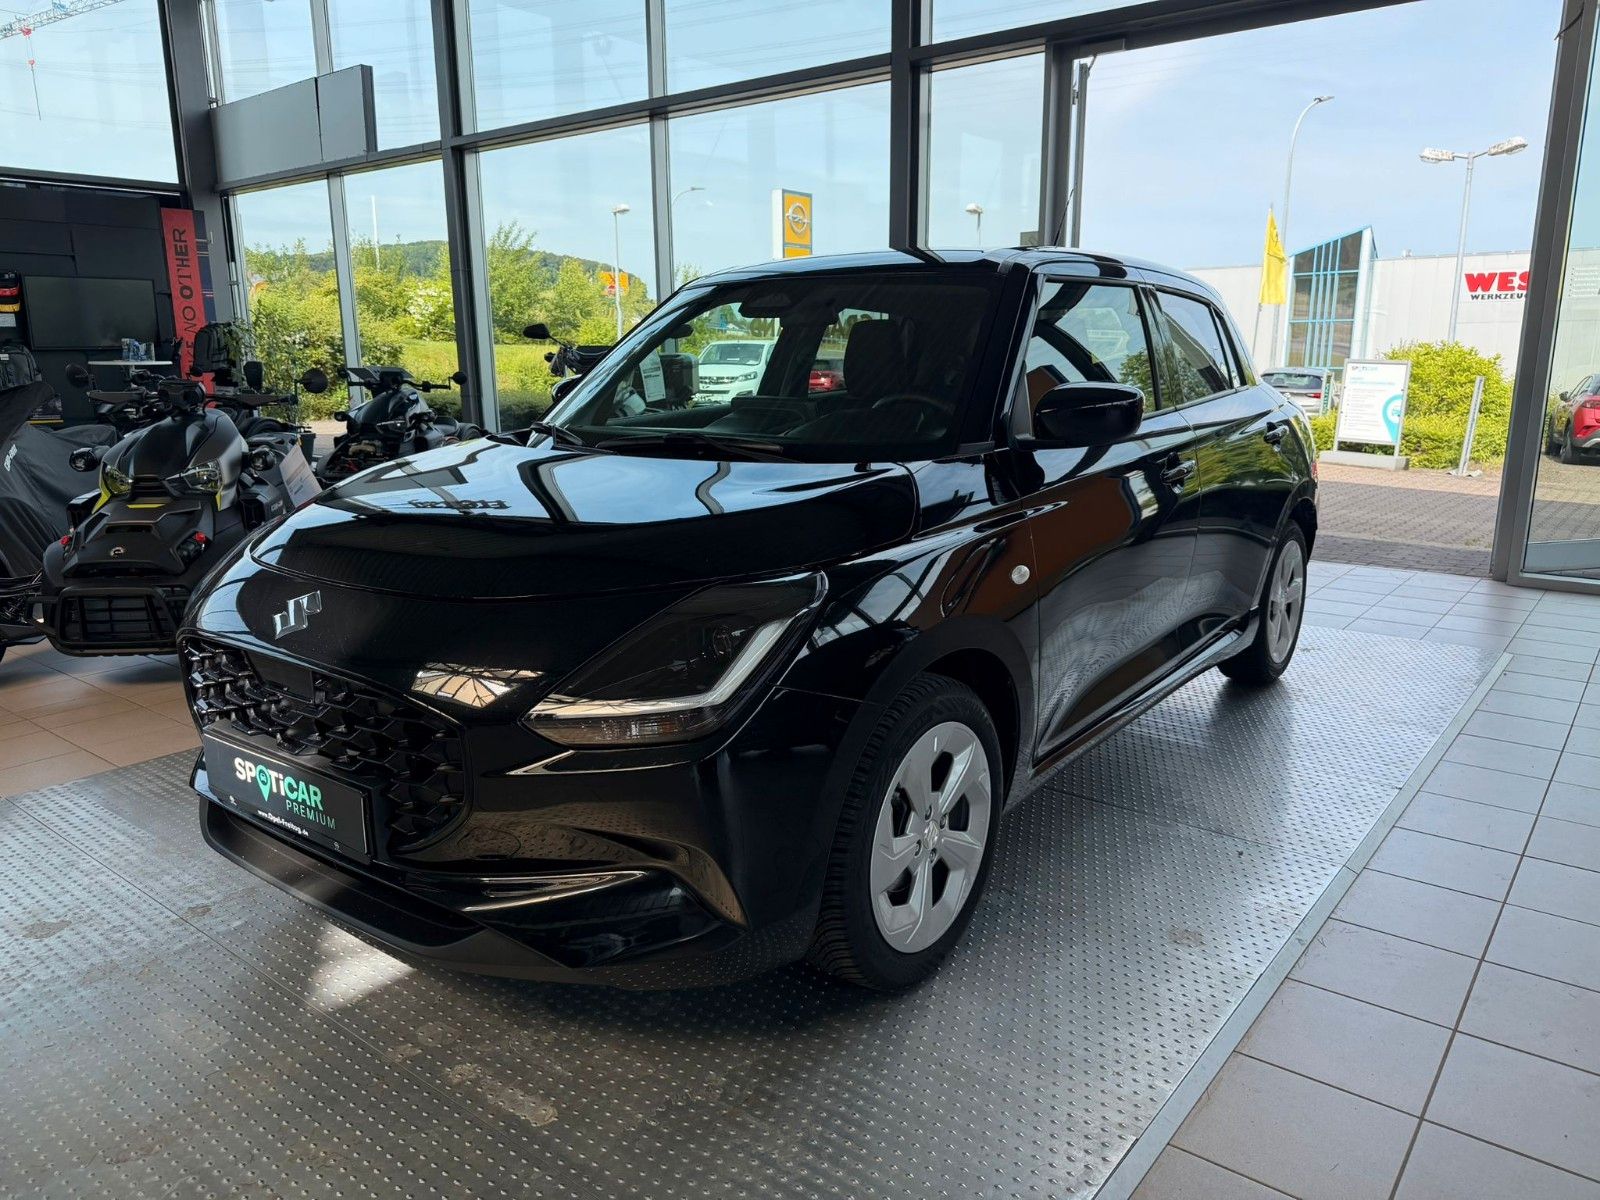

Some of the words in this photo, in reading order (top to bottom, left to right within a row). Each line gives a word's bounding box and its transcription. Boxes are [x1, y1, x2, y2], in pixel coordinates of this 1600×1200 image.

[172, 228, 194, 300] OTHER
[1470, 292, 1526, 300] WERKZEU
[182, 305, 197, 334] NO
[286, 799, 336, 830] PREMIUM
